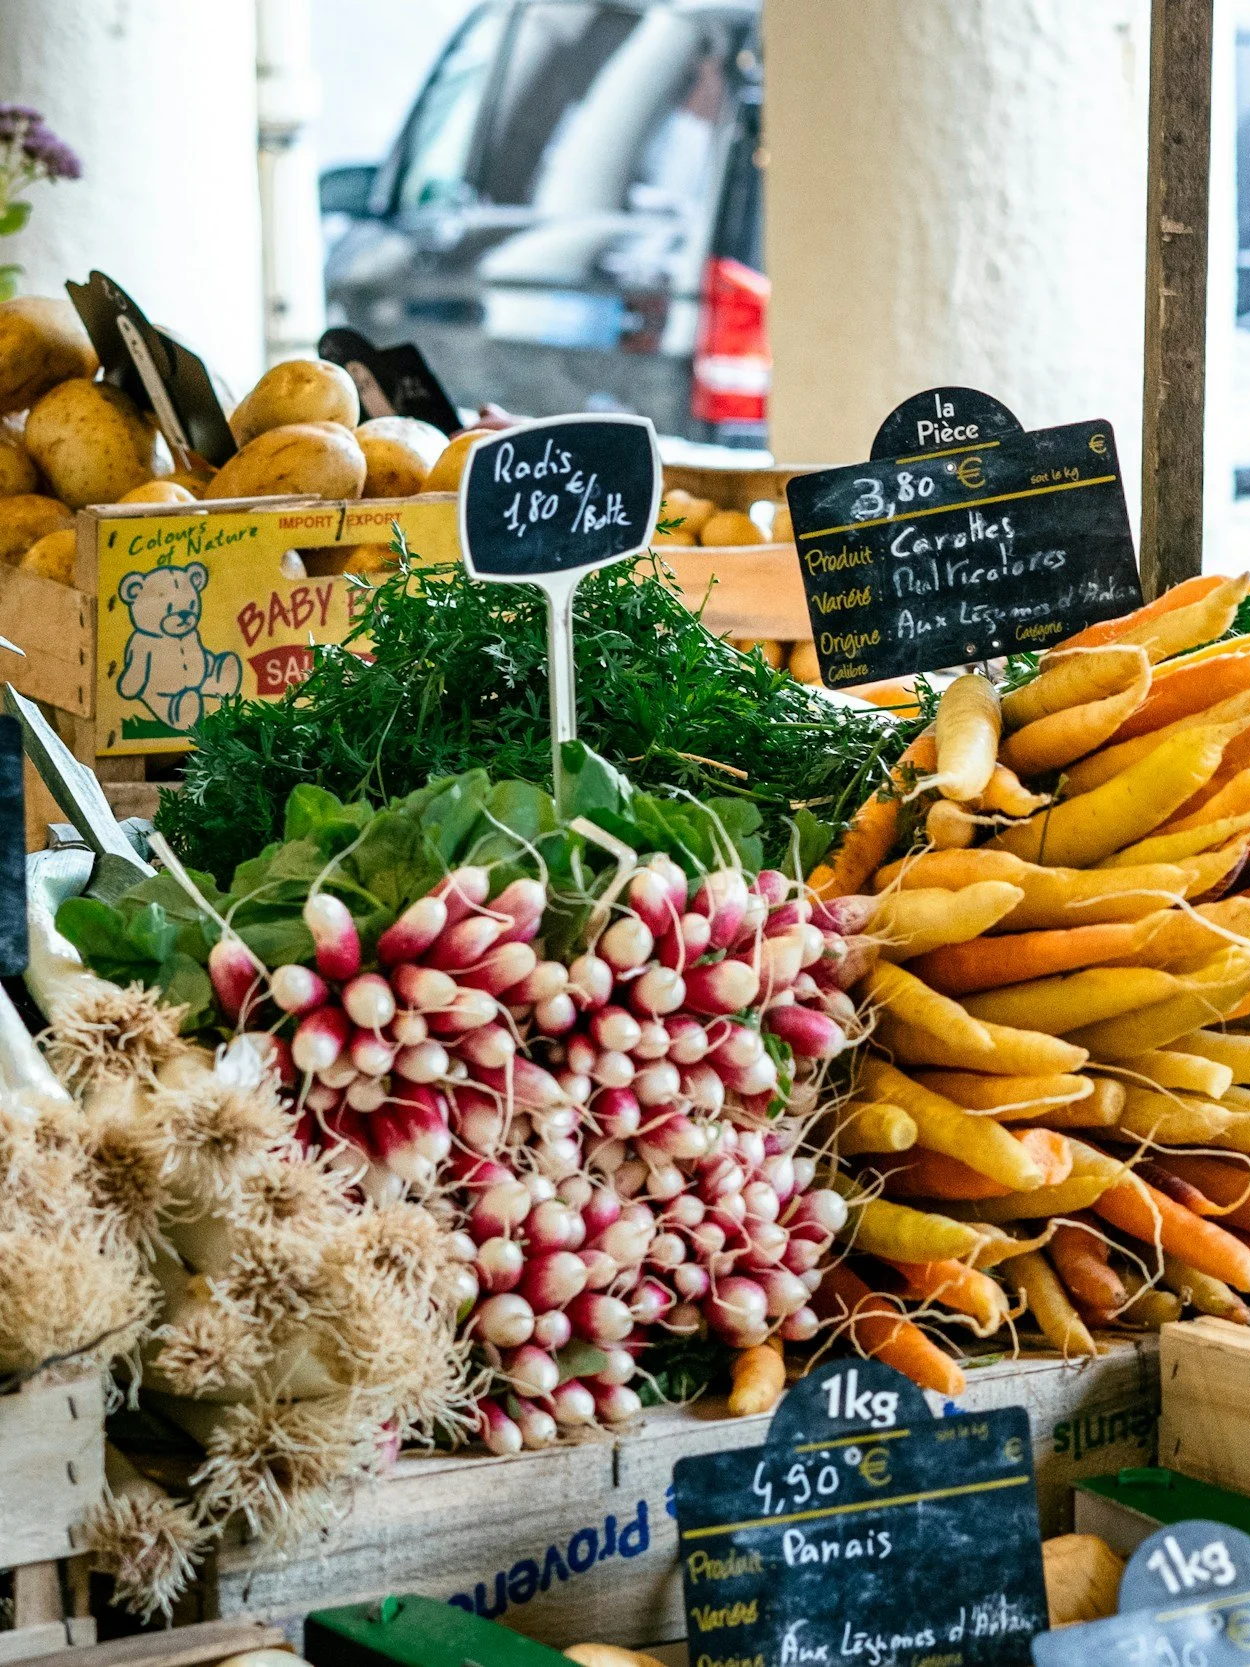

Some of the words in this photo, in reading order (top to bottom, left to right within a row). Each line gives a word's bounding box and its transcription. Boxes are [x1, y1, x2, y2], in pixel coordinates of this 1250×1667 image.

[934, 393, 954, 419] la
[917, 420, 980, 446] Pièce
[1088, 434, 1107, 454] €
[495, 439, 573, 483] Radis
[1064, 466, 1079, 481] kg
[853, 471, 935, 520] 3,80
[956, 457, 986, 489] €
[278, 515, 334, 530] IMPORT
[346, 511, 403, 527] EXPORT
[503, 490, 559, 537] 1,80
[129, 521, 207, 556] Colours
[157, 549, 174, 565] of
[187, 525, 258, 556] Nature
[805, 545, 873, 576] Produit
[890, 509, 1016, 558] Carottes
[237, 583, 333, 648] BABY
[811, 585, 873, 615] Variété
[820, 629, 881, 660] Origine
[897, 609, 947, 639] Aux
[1016, 621, 1063, 642] Catégorie
[828, 663, 868, 684] Calibre
[822, 1369, 899, 1428] 1kg
[1003, 1436, 1024, 1463] €
[753, 1461, 839, 1514] 4,90
[859, 1447, 893, 1488] €
[687, 1548, 764, 1584] Produit
[782, 1529, 893, 1566] Panais
[1146, 1536, 1236, 1594] 1kg
[781, 1619, 829, 1665] Aux
